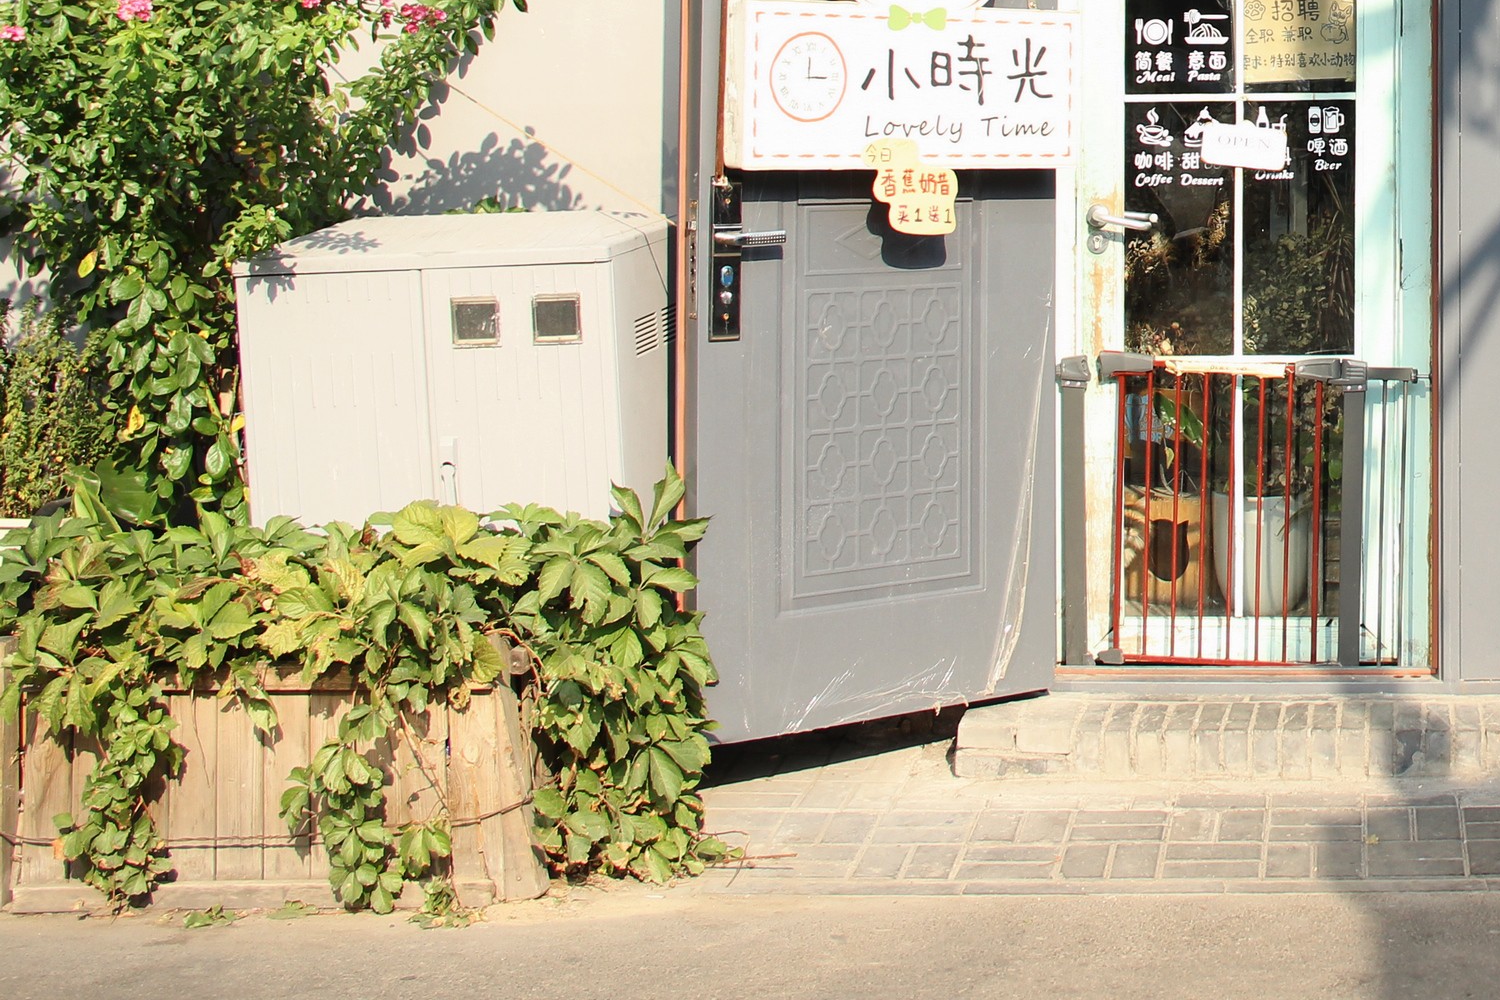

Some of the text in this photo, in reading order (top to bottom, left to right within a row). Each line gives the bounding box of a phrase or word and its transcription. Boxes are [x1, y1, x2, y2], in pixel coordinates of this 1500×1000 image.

[1246, 26, 1313, 44] 全职 兼职
[861, 34, 1053, 105] 小時光
[1135, 50, 1227, 71] 简餐 意面
[1136, 70, 1221, 84] Meal Pasta
[864, 115, 1055, 143] Lovely Time
[866, 144, 891, 163] 今日
[1307, 138, 1348, 156] 啤酒
[1134, 151, 1173, 171] 咖啡
[1315, 159, 1342, 170] Beer
[881, 168, 949, 197] 香蕉奶昔
[1135, 173, 1173, 187] Coffee
[1180, 173, 1224, 186] Dessert
